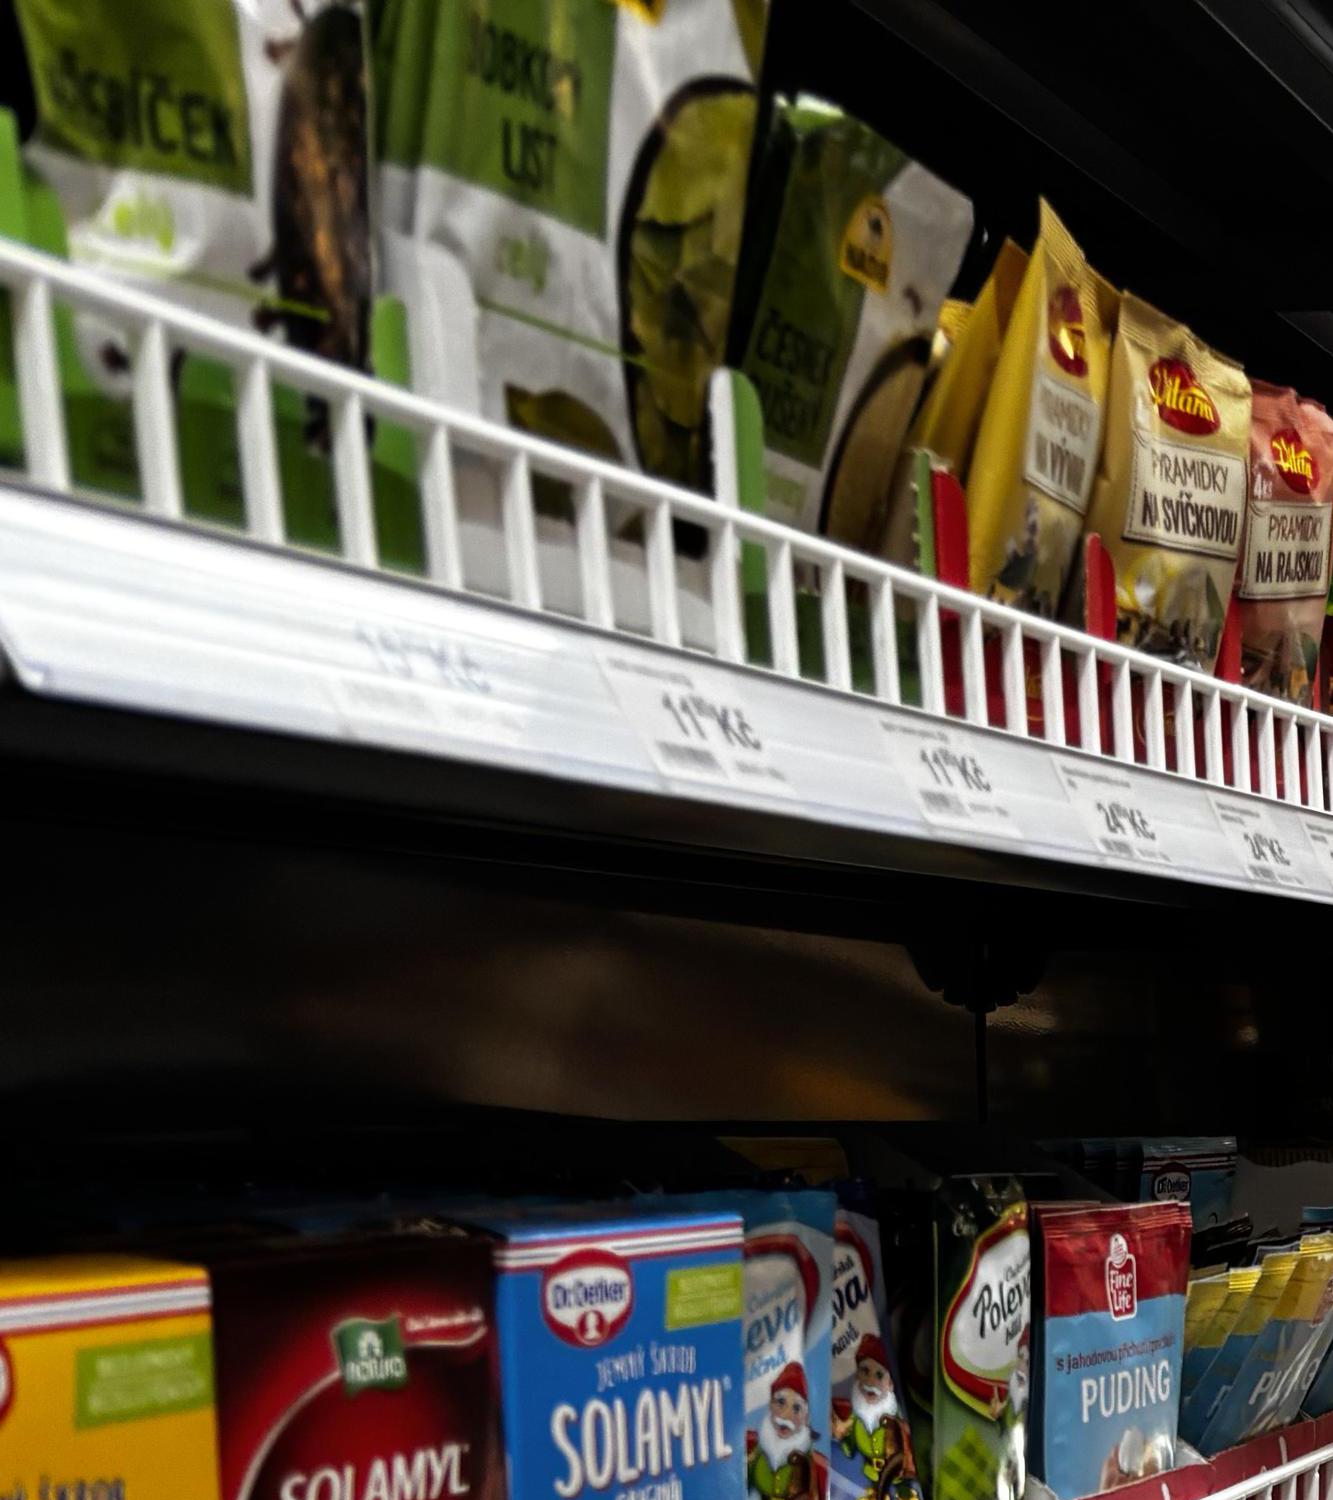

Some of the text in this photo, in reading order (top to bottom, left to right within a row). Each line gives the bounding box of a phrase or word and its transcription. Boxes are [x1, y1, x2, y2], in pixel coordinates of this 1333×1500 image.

[1255, 551, 1273, 585] NA
[1110, 1269, 1134, 1293] Fine
[1112, 1290, 1132, 1313] Life
[1081, 1359, 1171, 1424] PUDING
[550, 1375, 734, 1500] SOLAMYL
